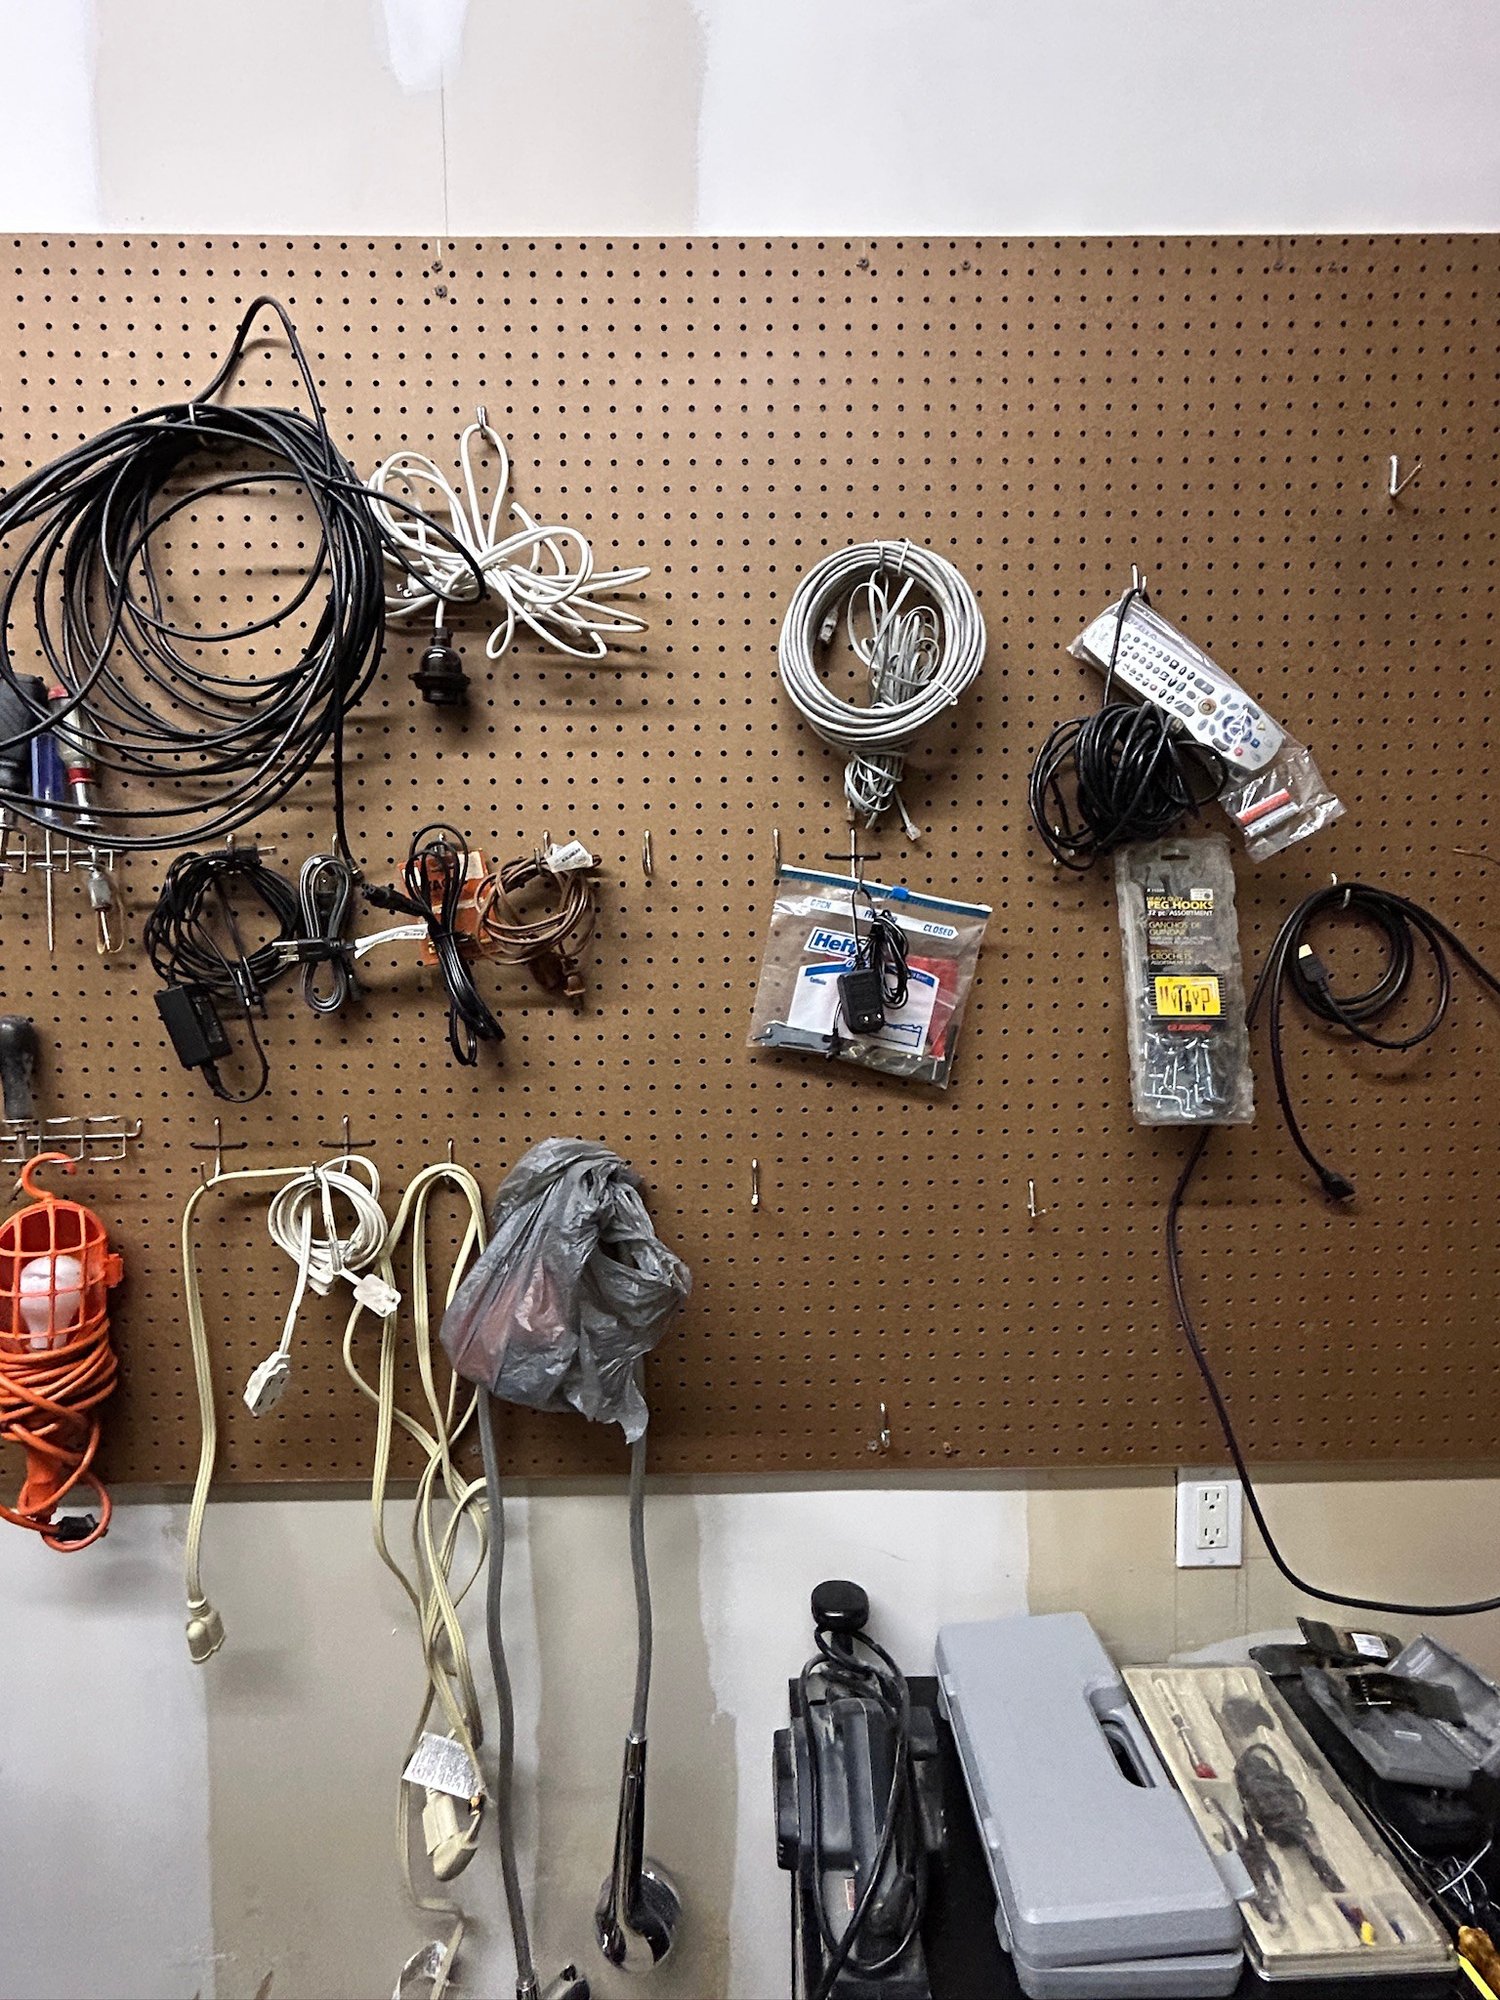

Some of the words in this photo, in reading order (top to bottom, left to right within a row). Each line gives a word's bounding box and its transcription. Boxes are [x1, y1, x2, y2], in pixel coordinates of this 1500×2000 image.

[1147, 901, 1169, 910] PEG
[1173, 901, 1214, 910] HOOKS
[923, 924, 954, 936] CLOSED
[814, 932, 859, 955] Heft
